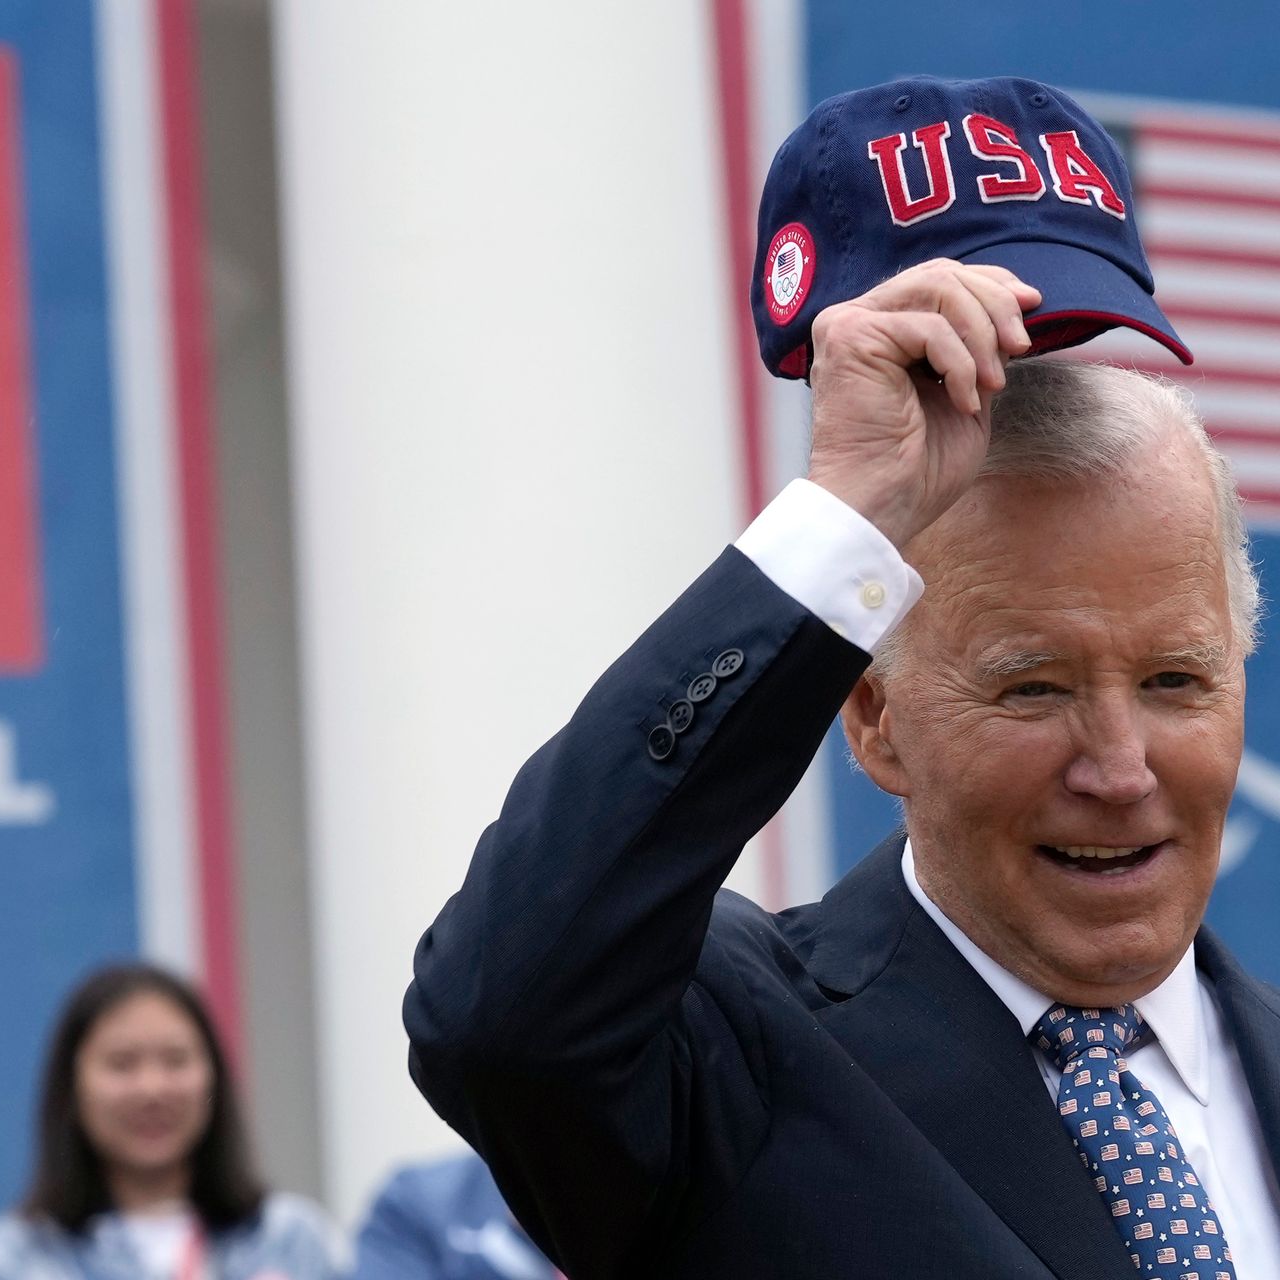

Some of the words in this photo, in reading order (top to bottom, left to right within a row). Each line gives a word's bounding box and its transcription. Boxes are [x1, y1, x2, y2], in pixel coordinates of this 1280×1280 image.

[867, 112, 1126, 228] USA
[770, 234, 787, 263] UNITED
[787, 231, 806, 248] STATES
[771, 301, 789, 316] OLYMPIC
[790, 287, 804, 310] TEAM
